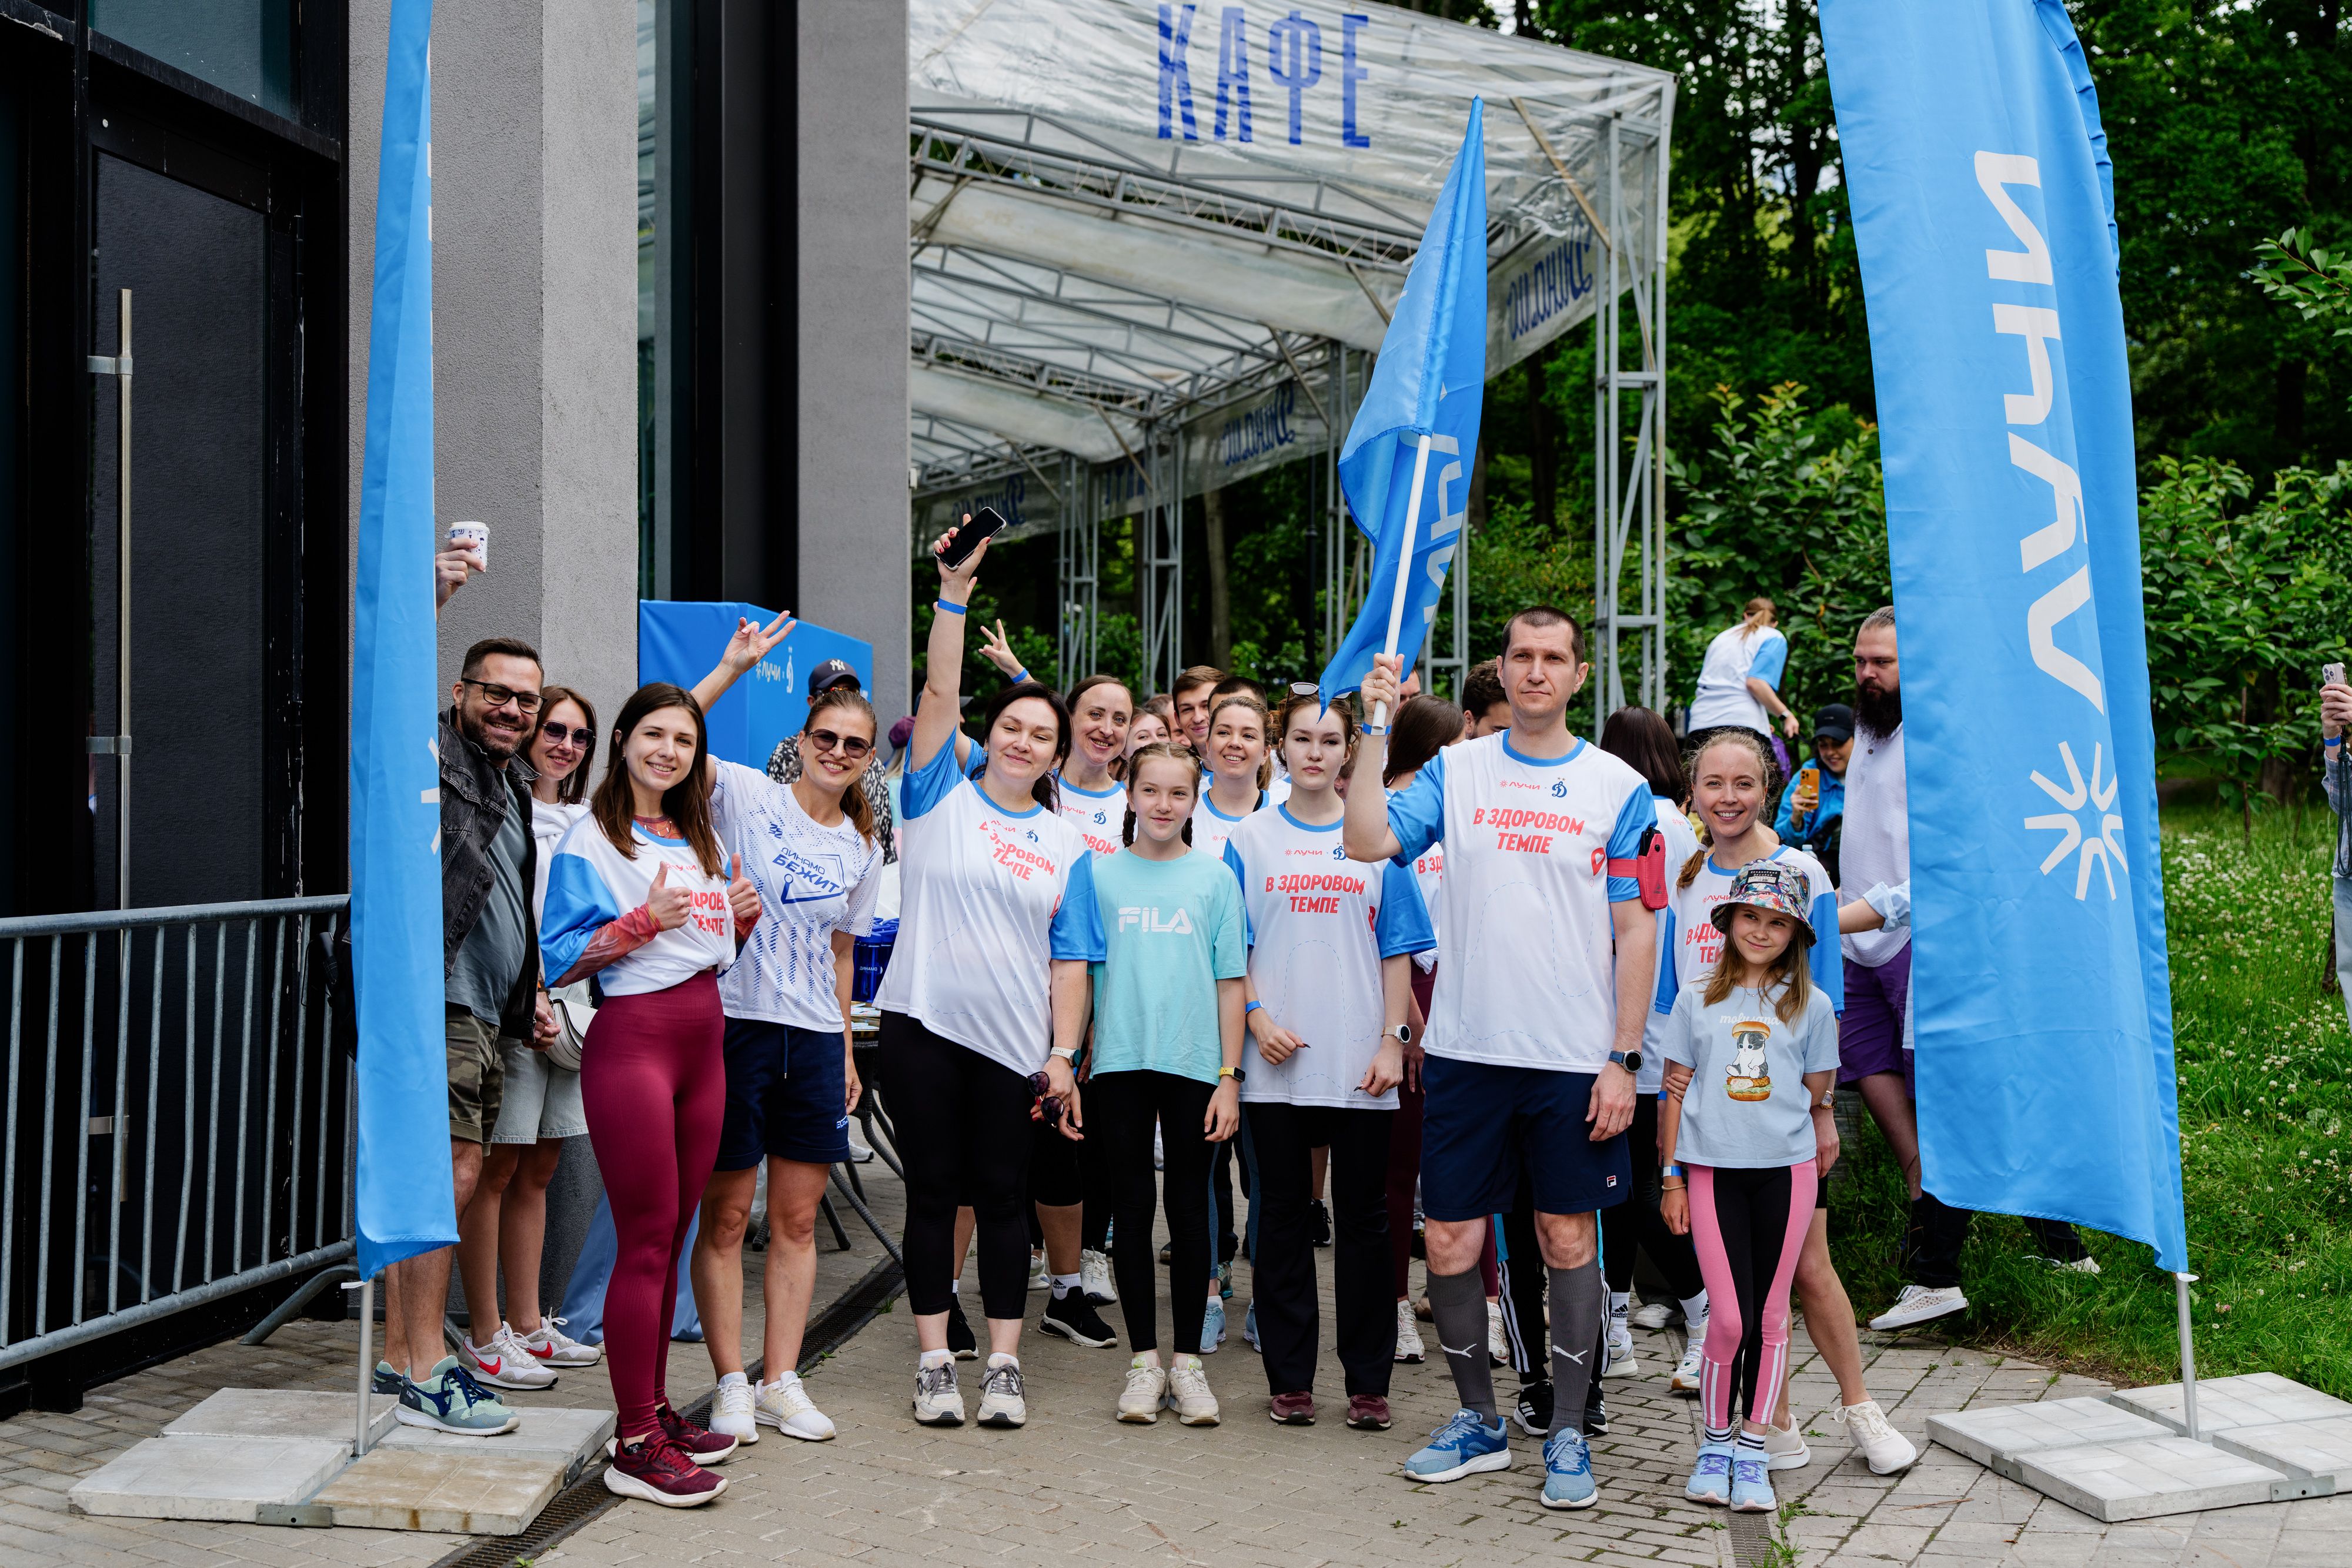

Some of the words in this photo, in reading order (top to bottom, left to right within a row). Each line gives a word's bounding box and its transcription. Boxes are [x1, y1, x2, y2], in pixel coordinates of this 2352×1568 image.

[1158, 4, 1371, 149] КАФЕ
[1973, 149, 2104, 716] ЛУЧИ
[1509, 781, 1540, 790] ЛУЧИ
[1473, 808, 1485, 825] В
[1487, 808, 1585, 835] ЗДОРОВОМ
[1497, 833, 1553, 854] ТЕМПЕ
[772, 854, 840, 893] БЕЖИТ
[781, 847, 826, 875] ДИНАМО
[1418, 859, 1426, 874] В
[1265, 877, 1275, 892] В
[1278, 874, 1365, 895] ЗДОРОВОМ
[1289, 897, 1341, 914] ТЕМПЕ
[1118, 907, 1193, 935] FILA
